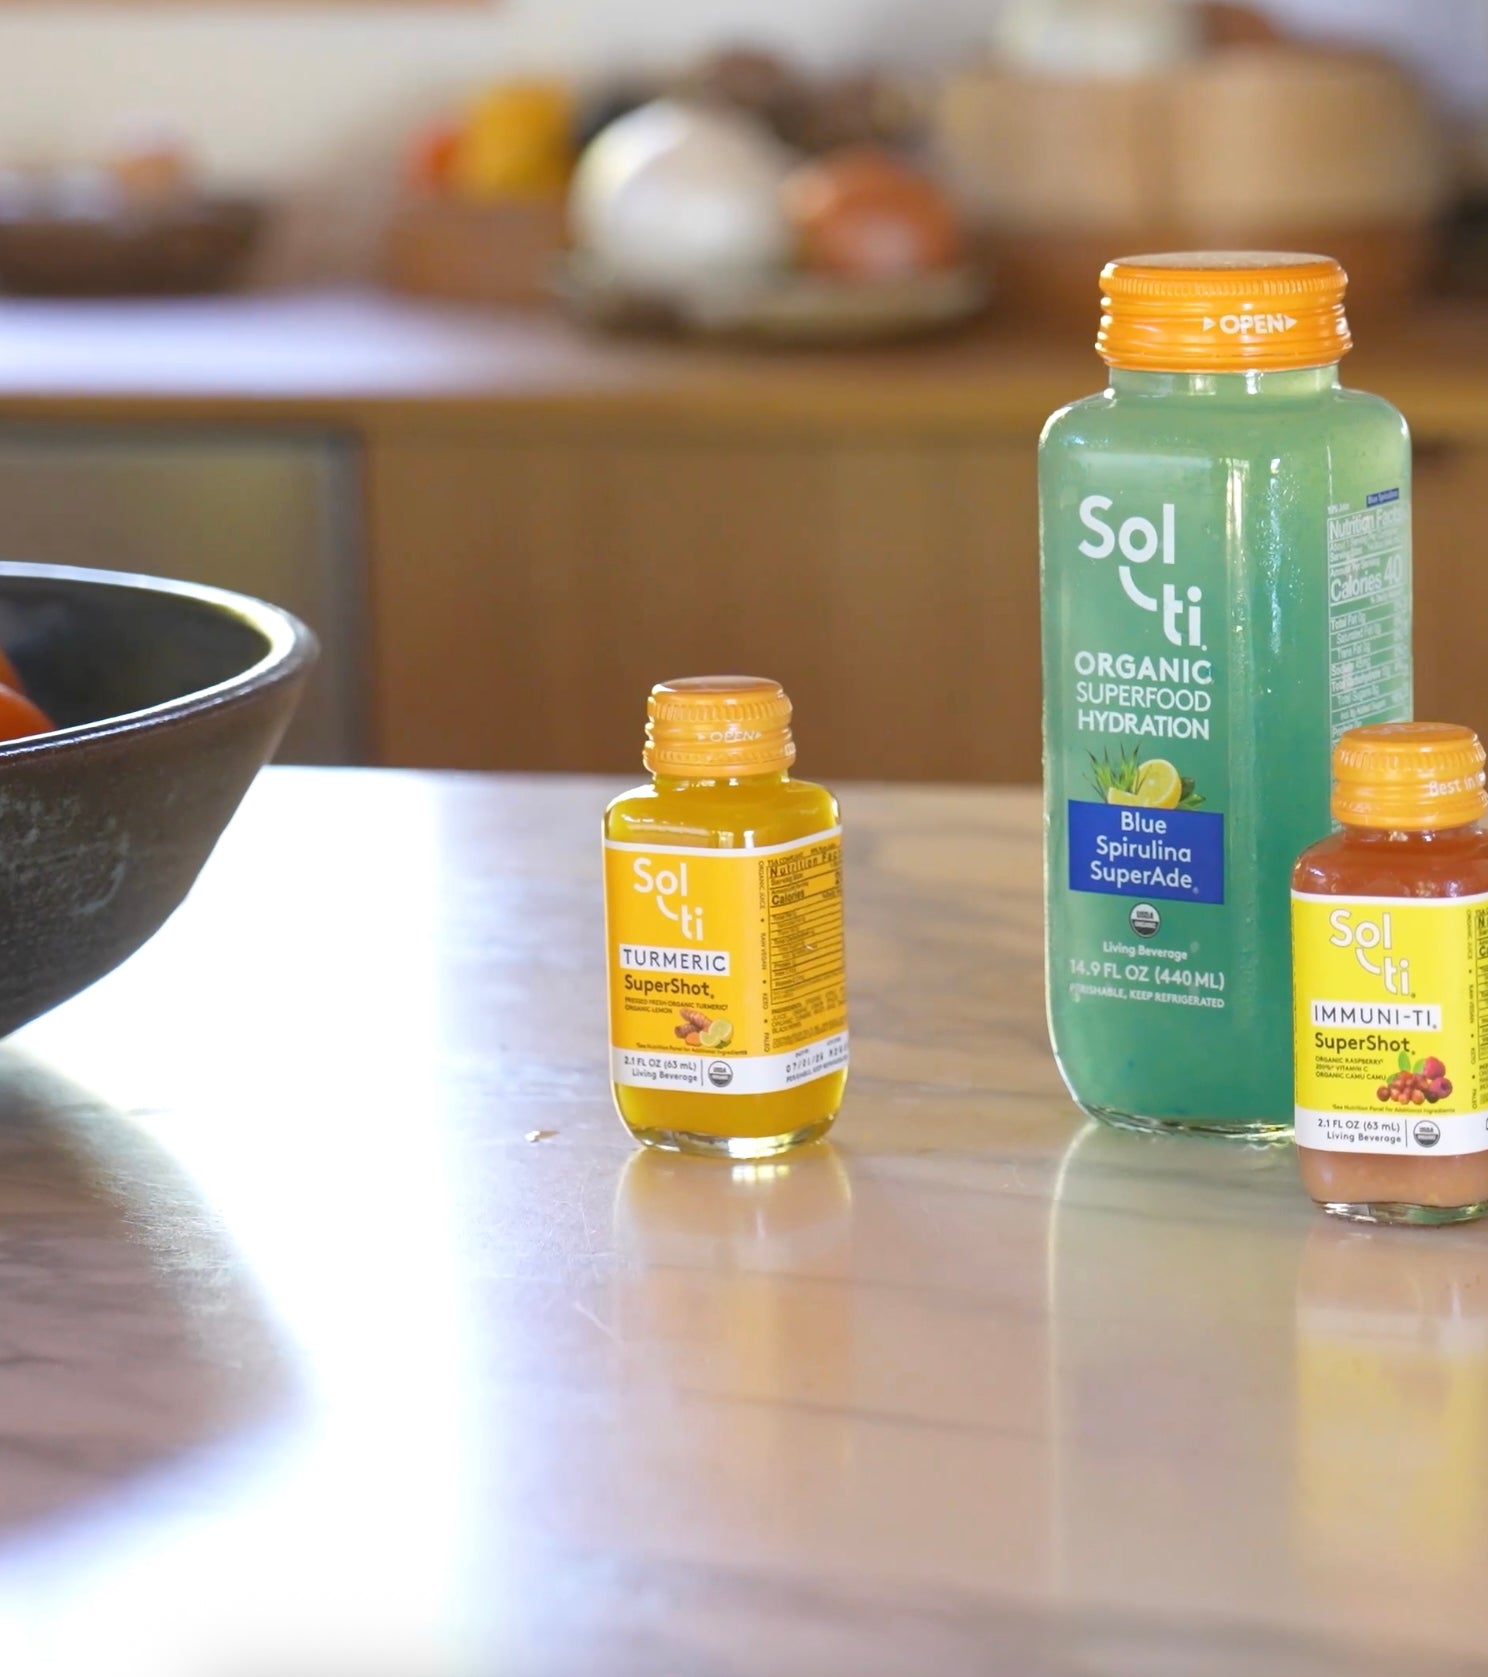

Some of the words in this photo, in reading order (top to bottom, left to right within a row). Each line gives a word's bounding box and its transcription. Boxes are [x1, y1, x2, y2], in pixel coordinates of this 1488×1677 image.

[1219, 315, 1286, 334] OPEN
[1078, 495, 1175, 564] Sol
[1329, 514, 1375, 540] Nutrition
[1331, 570, 1381, 601] Calories
[1383, 554, 1401, 585] 40
[1074, 650, 1212, 685] ORGANIC
[1076, 681, 1212, 712] SUPERFOOD
[1078, 709, 1210, 740] HYDRATION
[709, 731, 754, 743] OPEN
[1429, 779, 1462, 796] Best
[1121, 811, 1167, 834] Blue
[1096, 835, 1192, 862] Spirulina
[633, 857, 687, 896] Sol
[681, 904, 704, 941] ti
[1329, 908, 1392, 950] Sol
[623, 948, 726, 971] TURMERIC
[1103, 941, 1136, 957] Living
[1138, 945, 1188, 961] Beverage
[1069, 959, 1100, 977] 14.9
[1104, 963, 1121, 979] FL
[1125, 965, 1149, 982] OZ
[1155, 966, 1192, 985] (440
[1194, 972, 1225, 991] ML)
[1130, 990, 1153, 1001] KEEP
[1154, 992, 1225, 1008] REFRIGERATED
[624, 1056, 635, 1066] 2.1
[637, 1058, 646, 1067] FL
[649, 1059, 661, 1068] OZ
[664, 1060, 678, 1070] (63
[680, 1062, 697, 1071] mL)
[1315, 1055, 1343, 1064] ORGANIC
[632, 1069, 656, 1080] Living
[659, 1071, 697, 1083] Beverage
[1315, 1071, 1344, 1079] ORGANIC
[1318, 1118, 1330, 1128] 2.1
[1333, 1119, 1343, 1129] FL
[1346, 1119, 1360, 1129] OZ
[1363, 1121, 1379, 1132] (63
[1381, 1122, 1400, 1133] mL)
[1327, 1131, 1355, 1142] Living
[1358, 1133, 1401, 1145] Beverage
